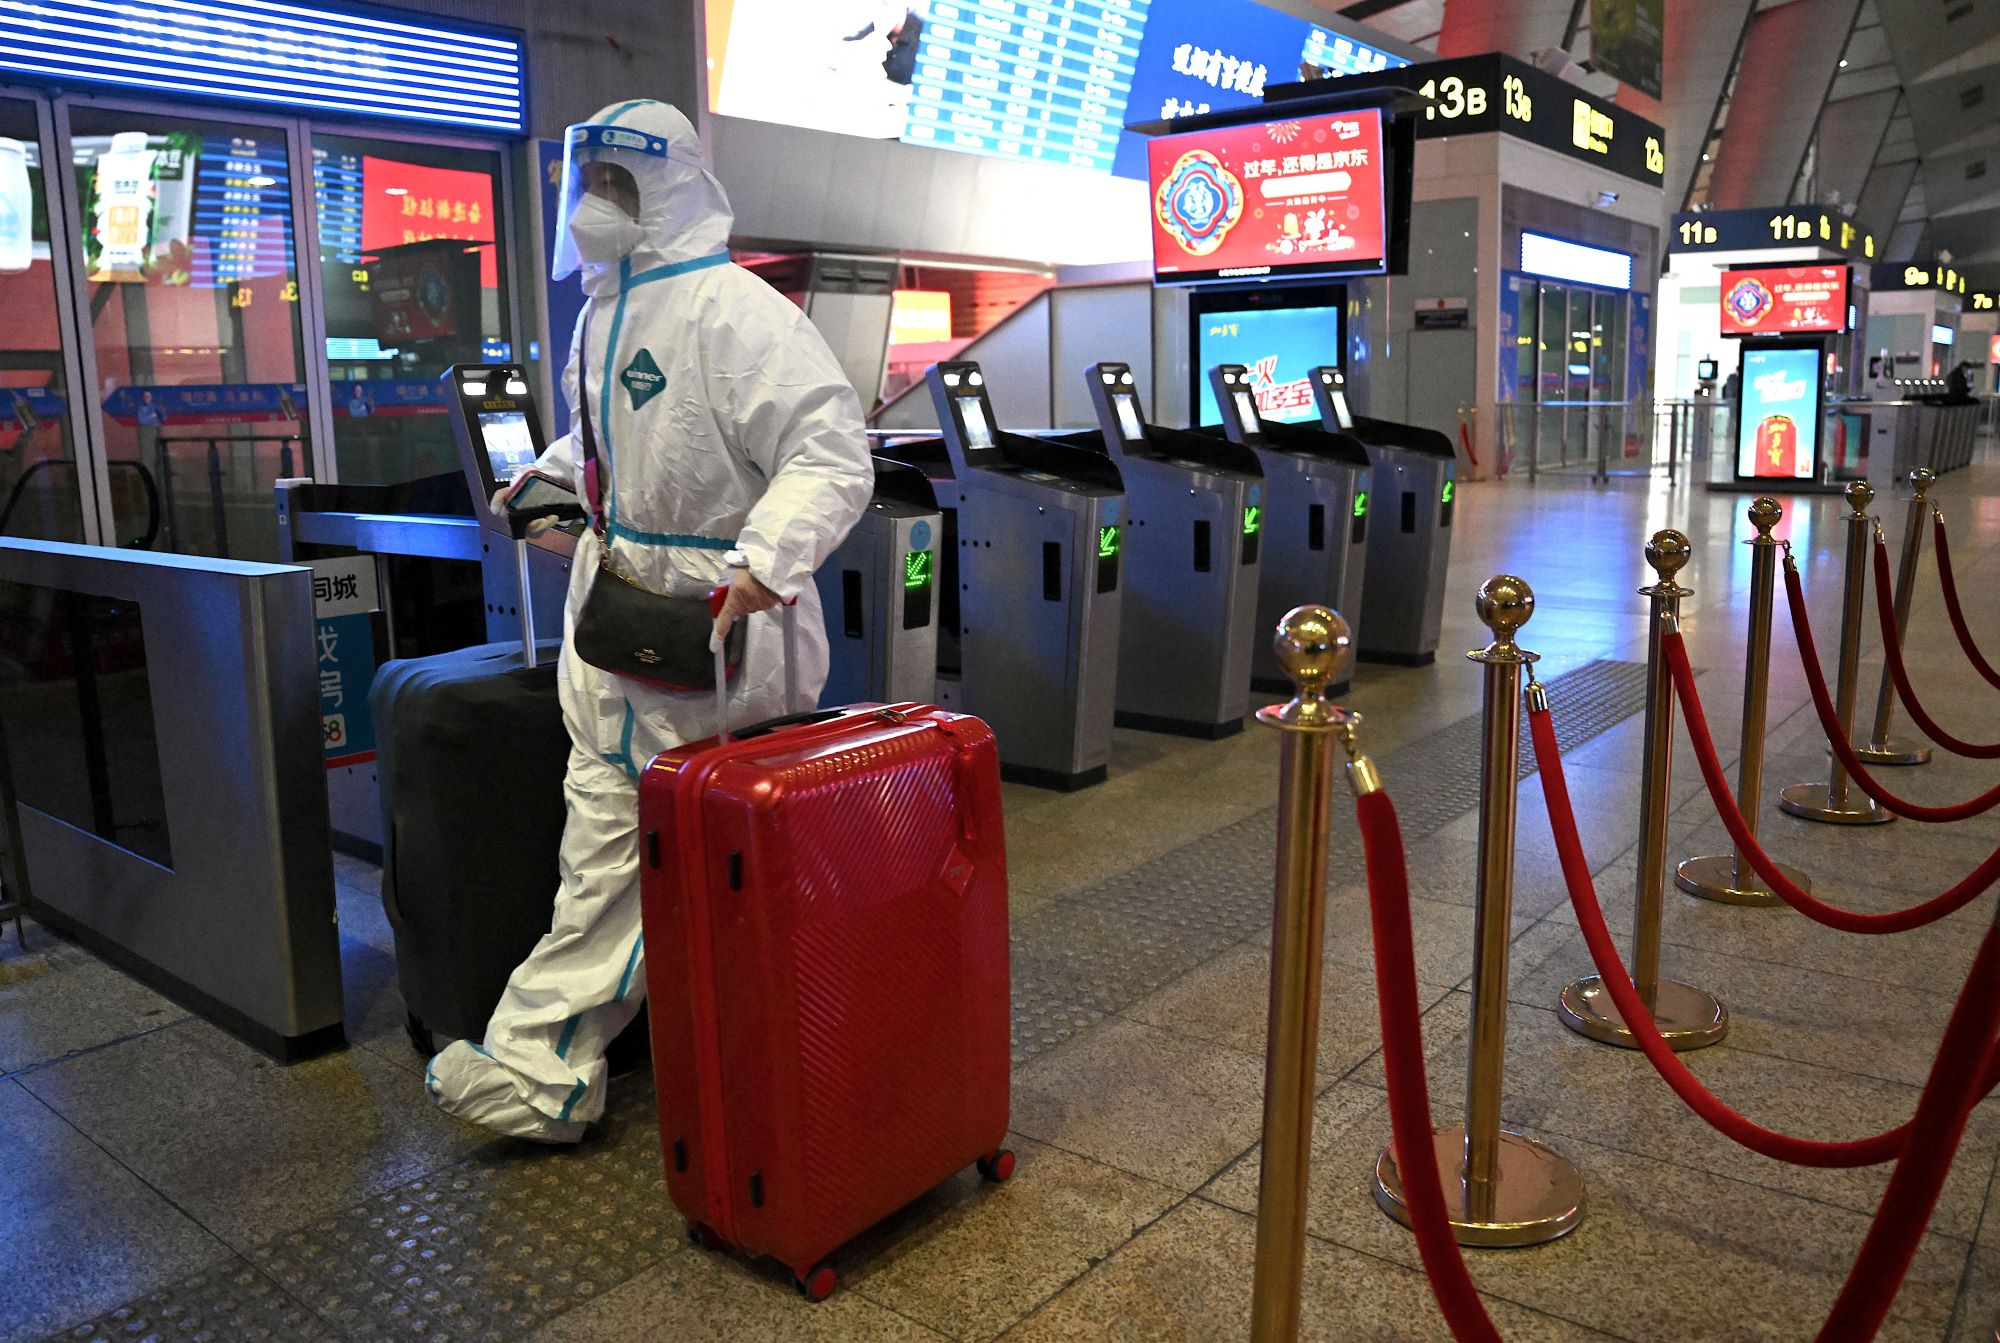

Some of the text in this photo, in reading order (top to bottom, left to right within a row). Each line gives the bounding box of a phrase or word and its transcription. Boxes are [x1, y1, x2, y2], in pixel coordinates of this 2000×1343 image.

[1419, 76, 1487, 120] 13B
[1503, 74, 1532, 122] 13B
[1244, 149, 1368, 178] 过年,还得是京东
[1680, 221, 1717, 245] 11B
[1769, 214, 1811, 240] 11B
